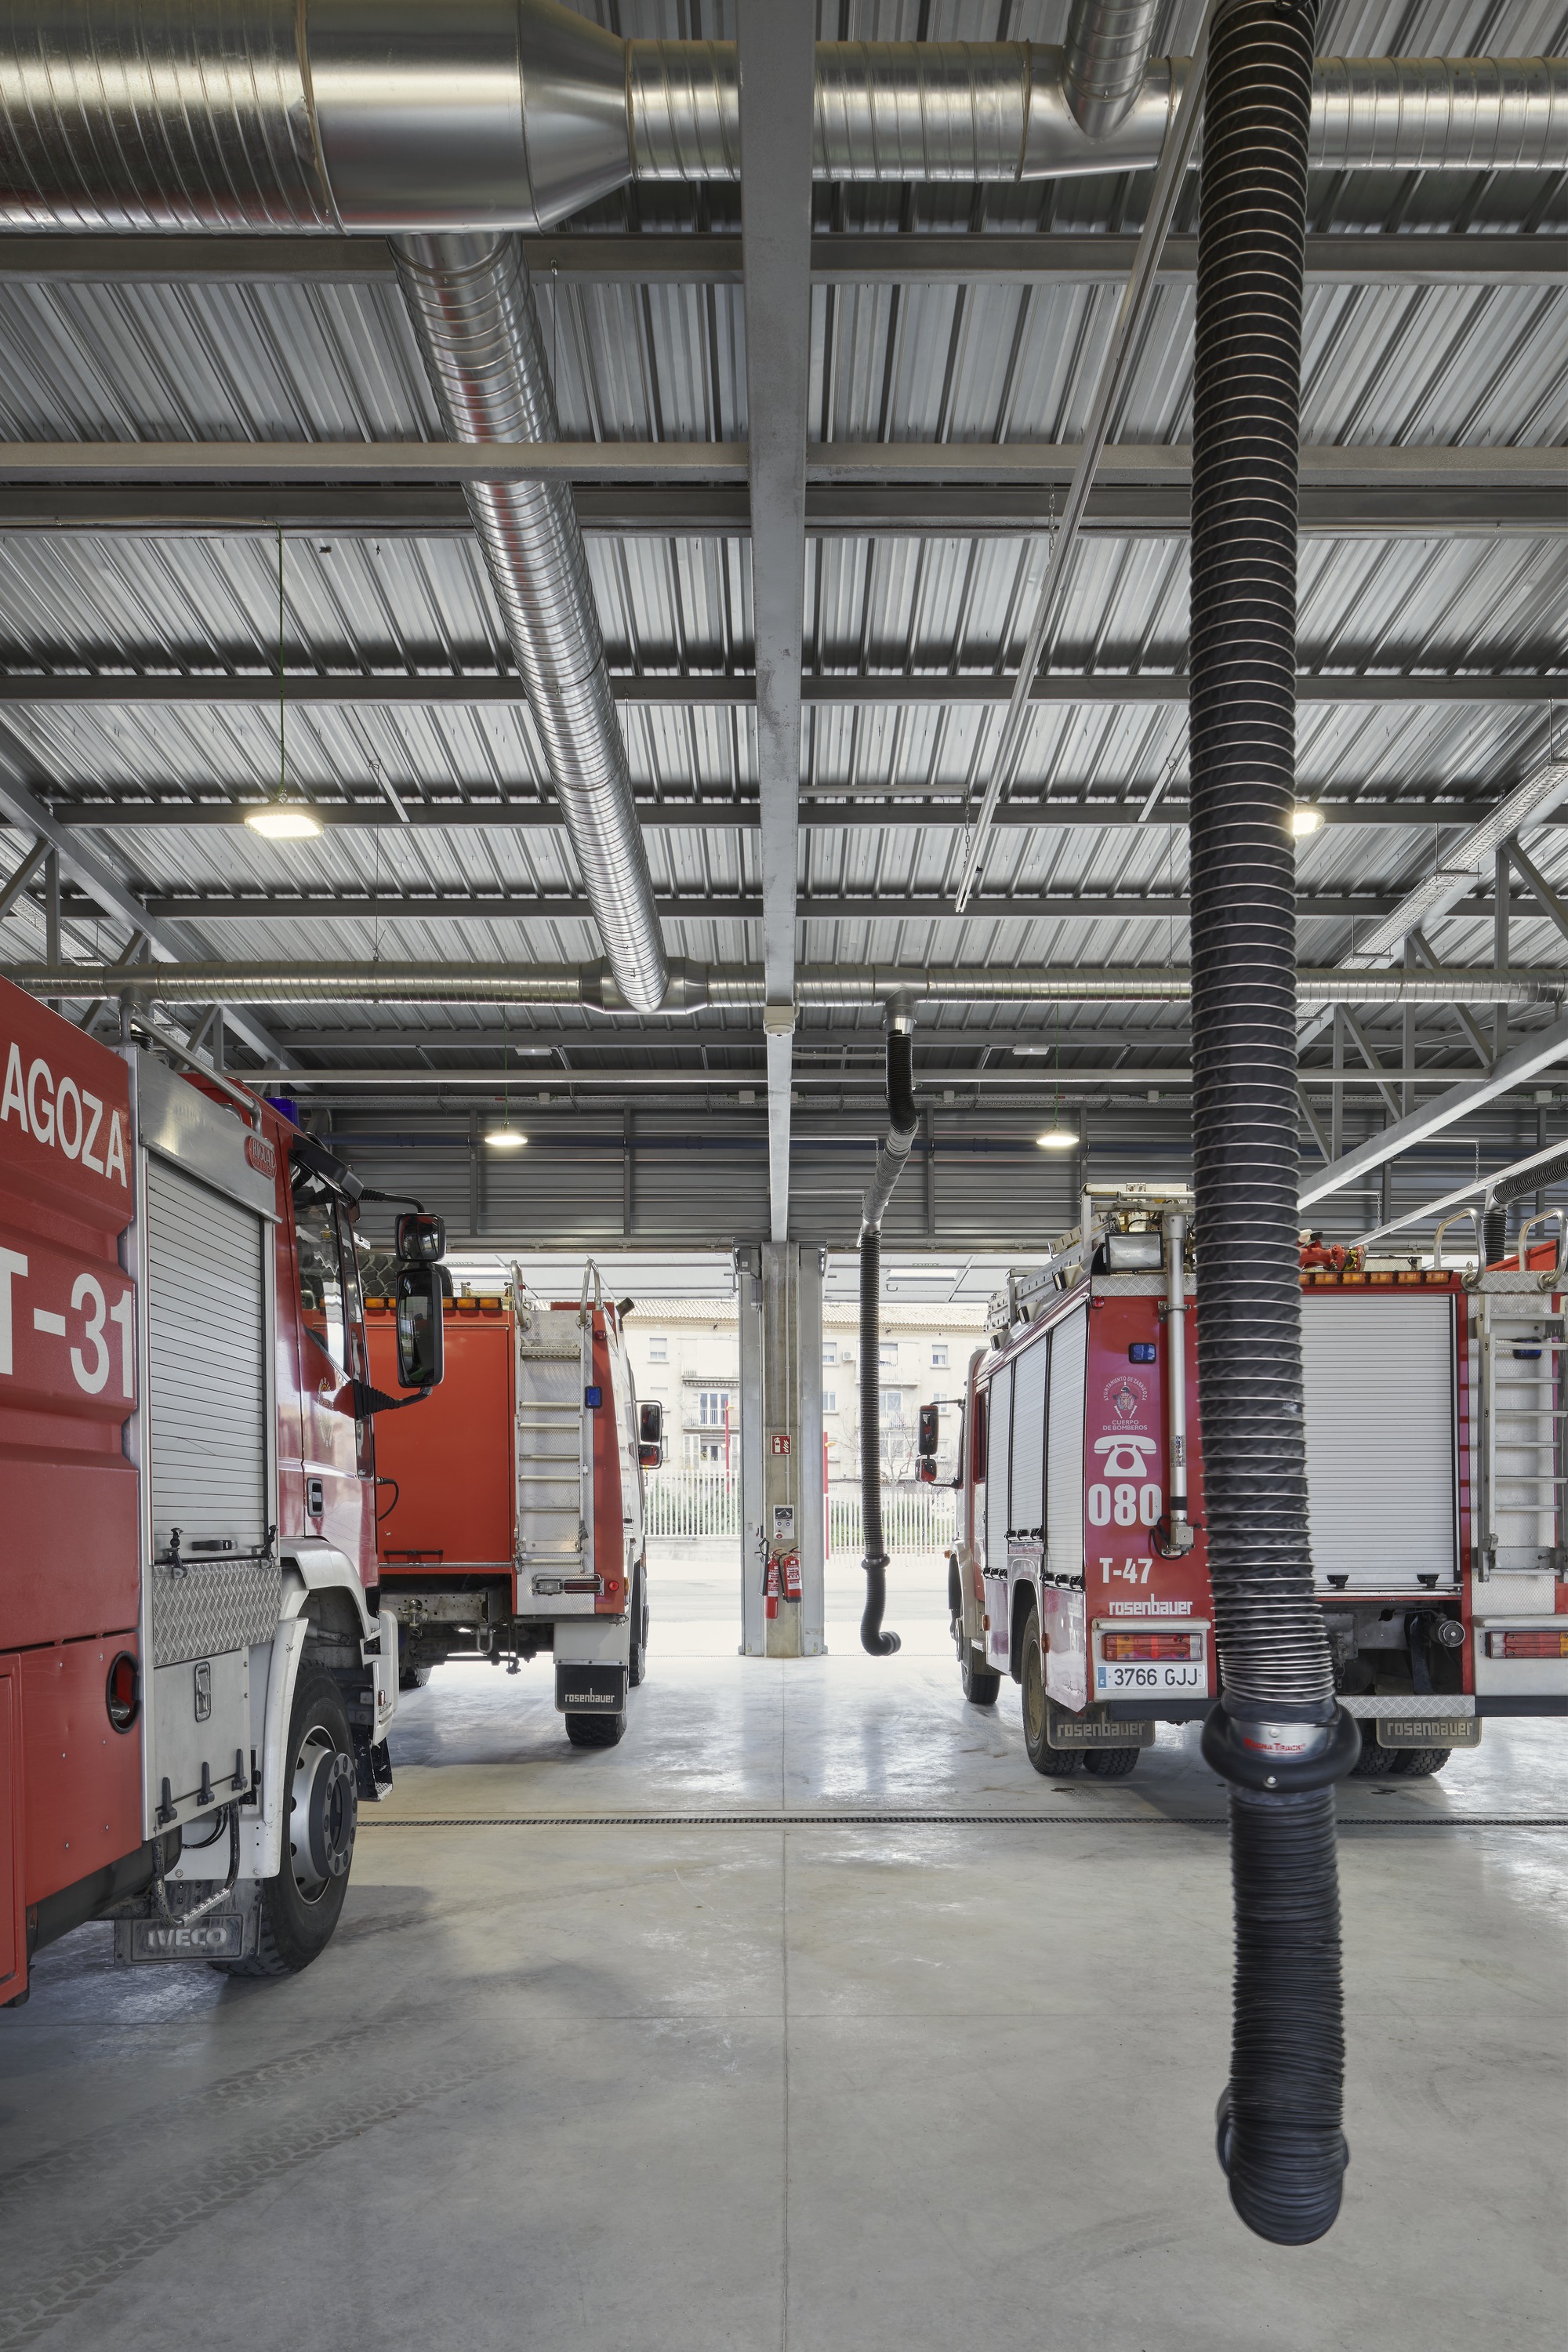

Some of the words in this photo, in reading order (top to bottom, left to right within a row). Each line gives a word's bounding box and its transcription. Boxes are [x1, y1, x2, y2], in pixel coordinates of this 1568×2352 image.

[0, 1041, 128, 1189] AGOZA
[252, 1138, 276, 1169] RIGUAL
[0, 1246, 133, 1399] T-31
[1103, 1376, 1127, 1402] AYUNTAMIENTO
[1133, 1378, 1148, 1401] ZARAGOZA
[1088, 1483, 1163, 1526] 080
[1099, 1557, 1153, 1584] T-47
[1109, 1593, 1193, 1616] rosenbauer
[1114, 1668, 1157, 1686] 3766
[1164, 1668, 1198, 1686] GJJ
[564, 1687, 615, 1704] rosenbauer
[1057, 1711, 1145, 1737] rosenbauer
[147, 1927, 228, 1947] IVECO
